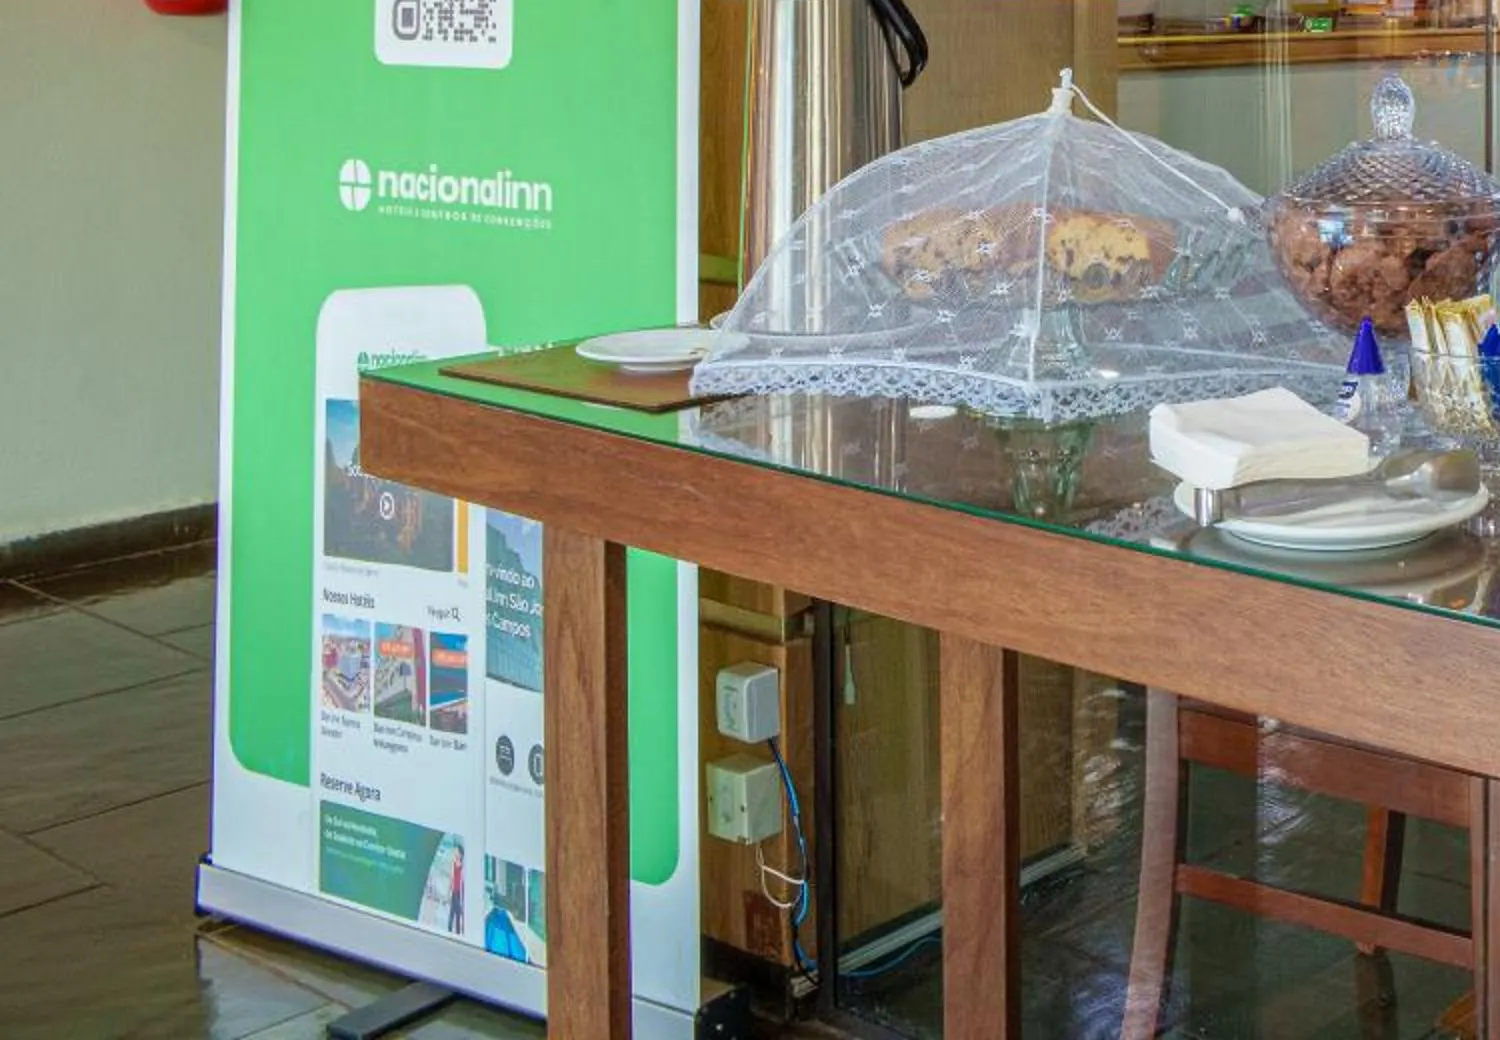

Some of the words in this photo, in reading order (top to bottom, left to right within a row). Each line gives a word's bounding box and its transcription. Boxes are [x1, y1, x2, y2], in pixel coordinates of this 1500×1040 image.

[378, 163, 553, 212] nacionalinn
[320, 772, 353, 795] Reserve
[354, 781, 381, 802] Agora
